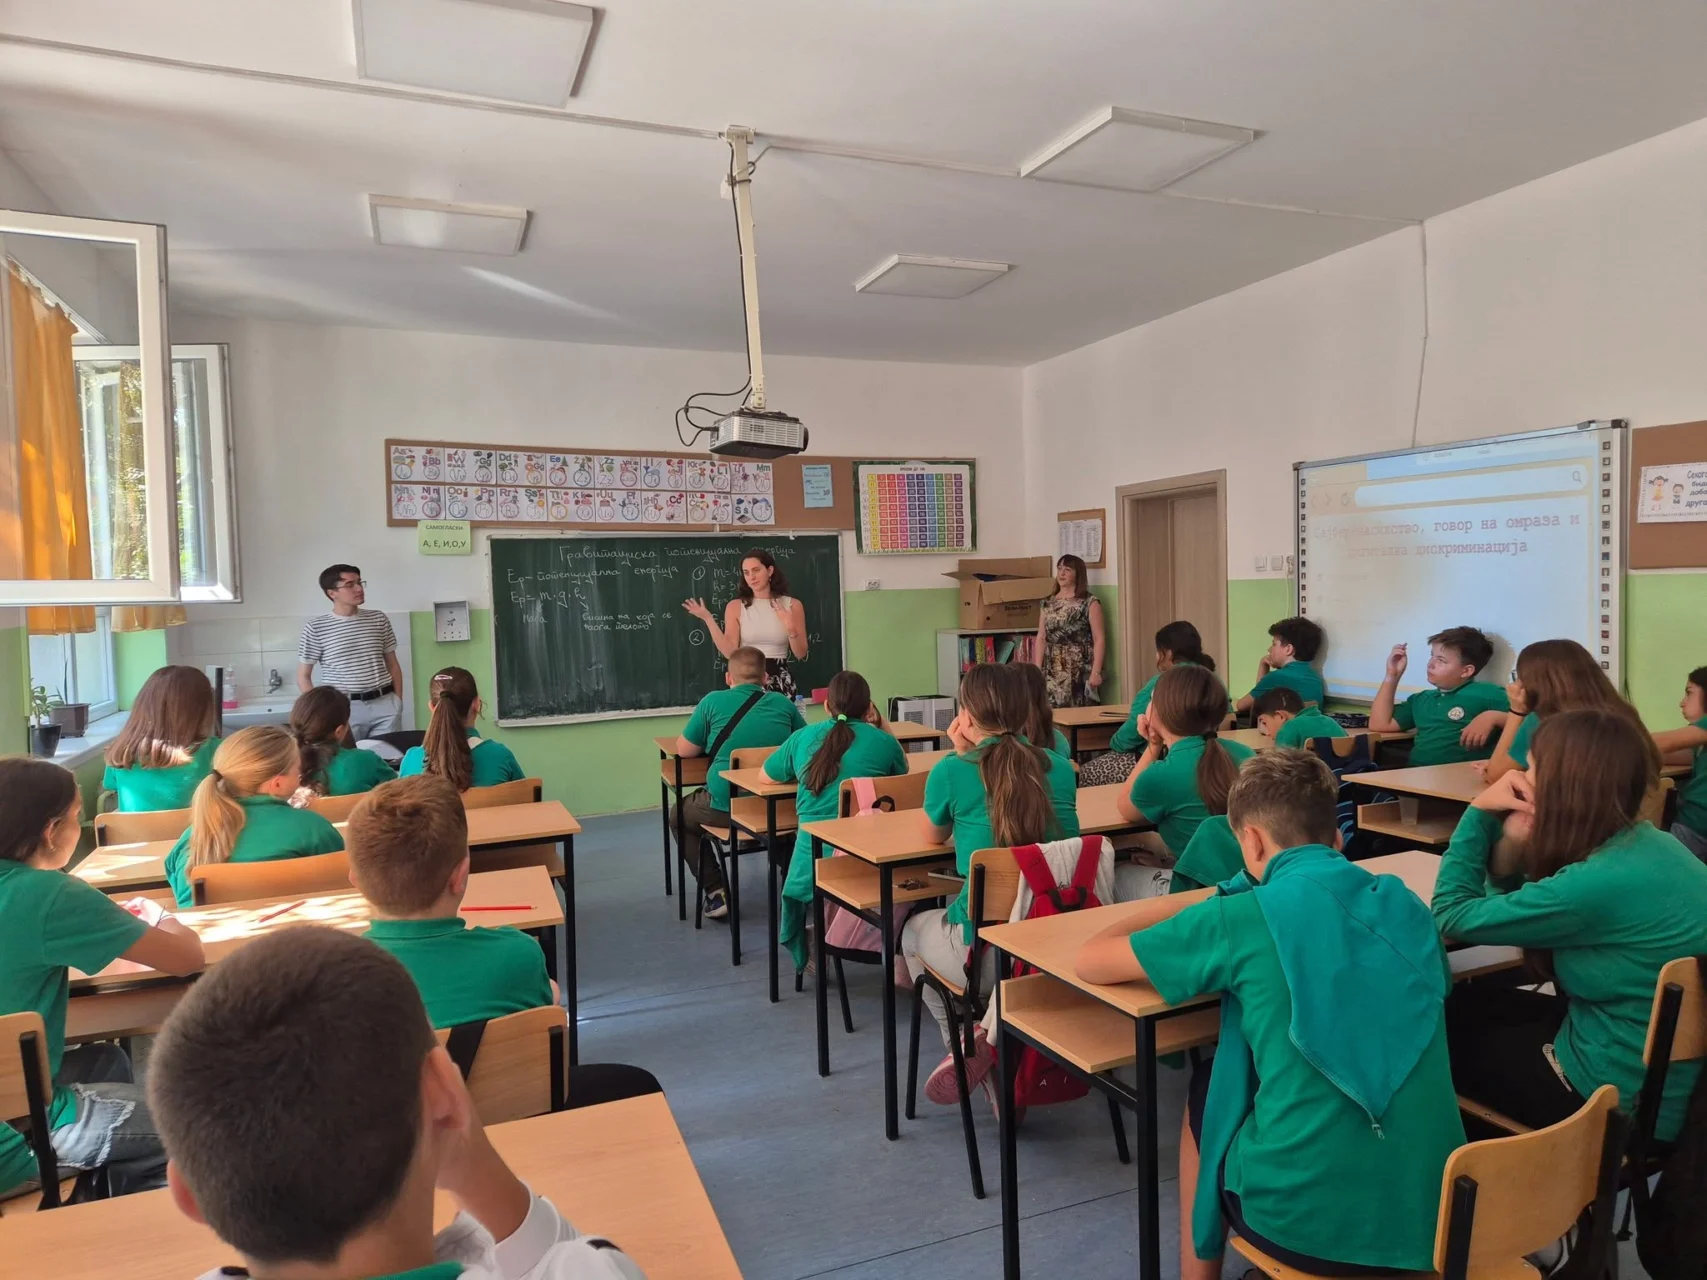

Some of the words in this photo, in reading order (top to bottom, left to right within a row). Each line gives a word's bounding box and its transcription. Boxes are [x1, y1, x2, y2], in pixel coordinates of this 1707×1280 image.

[1433, 519, 1473, 534] говор
[1481, 518, 1497, 530] на
[1506, 516, 1561, 534] омраза
[1569, 514, 1580, 526] и
[1415, 541, 1528, 558] дискриминација
